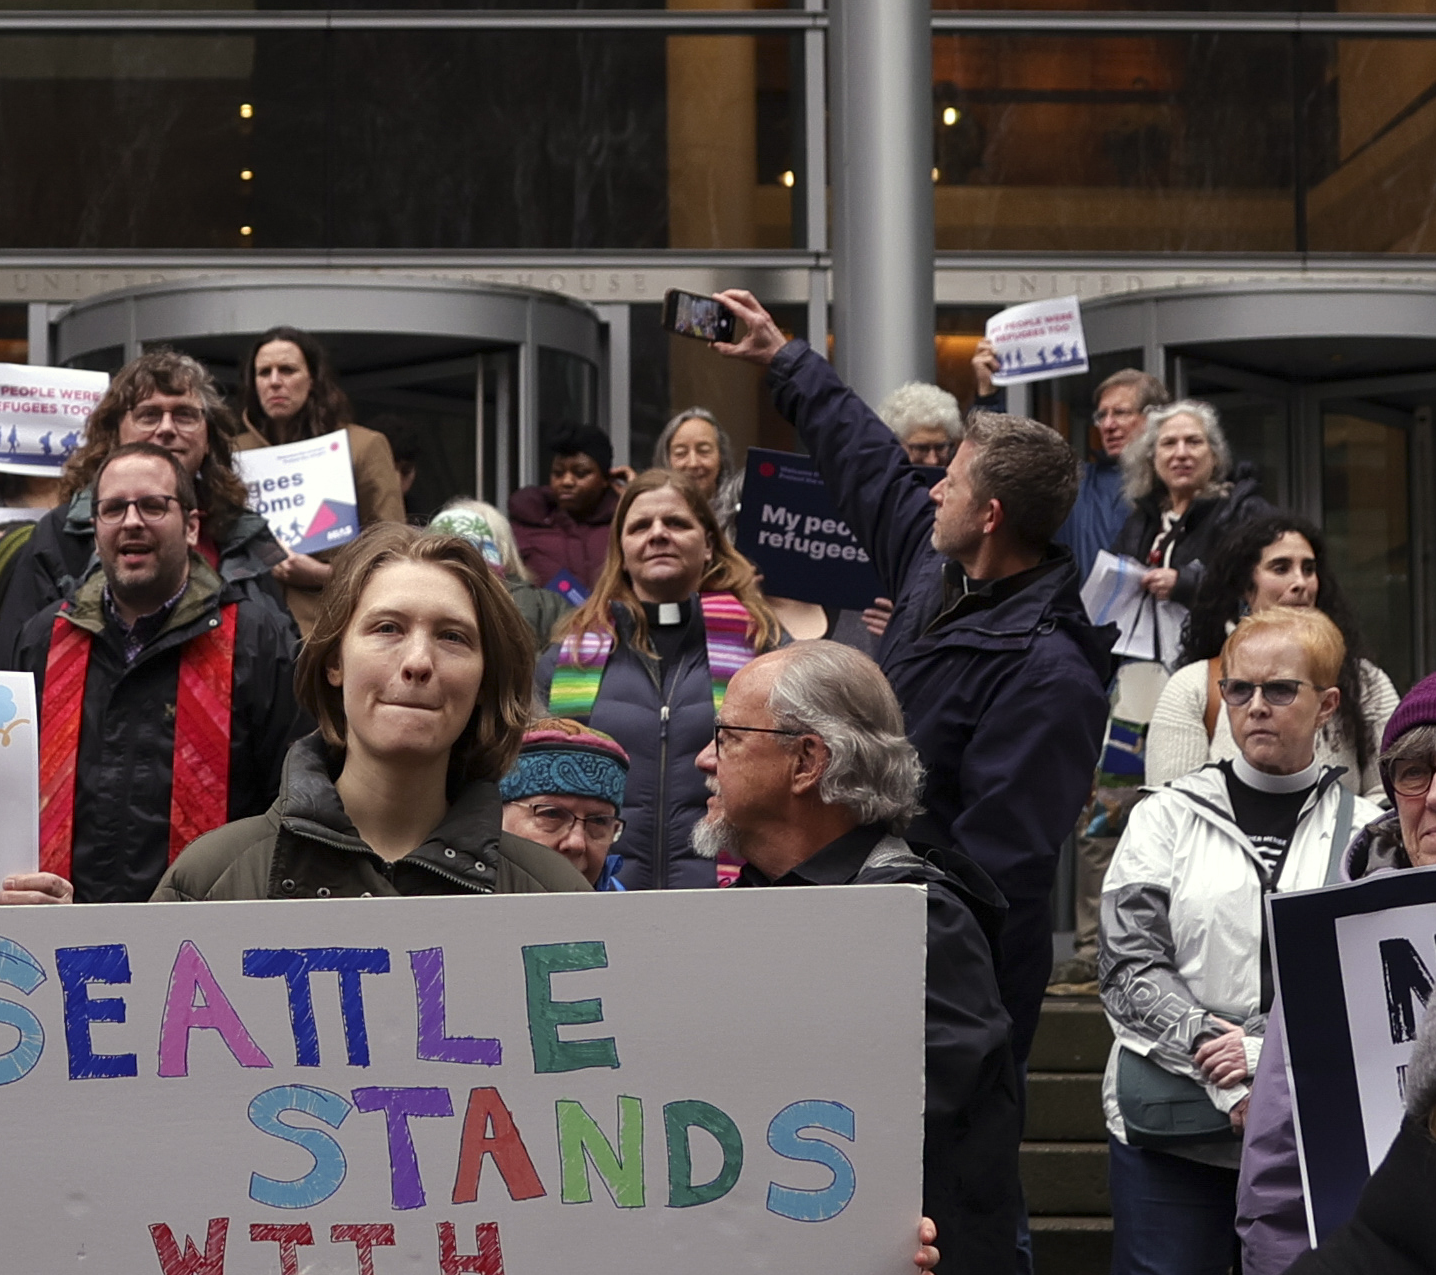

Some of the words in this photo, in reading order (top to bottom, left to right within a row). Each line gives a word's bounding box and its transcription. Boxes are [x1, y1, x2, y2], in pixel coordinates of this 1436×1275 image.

[989, 274, 1144, 295] UNITED
[0, 386, 56, 398] PEOPLE
[60, 389, 102, 402] WERE
[62, 403, 92, 416] TOO
[761, 503, 802, 531] My
[804, 516, 858, 543] peo
[758, 529, 871, 563] refugees
[247, 1083, 857, 1223] STANDS
